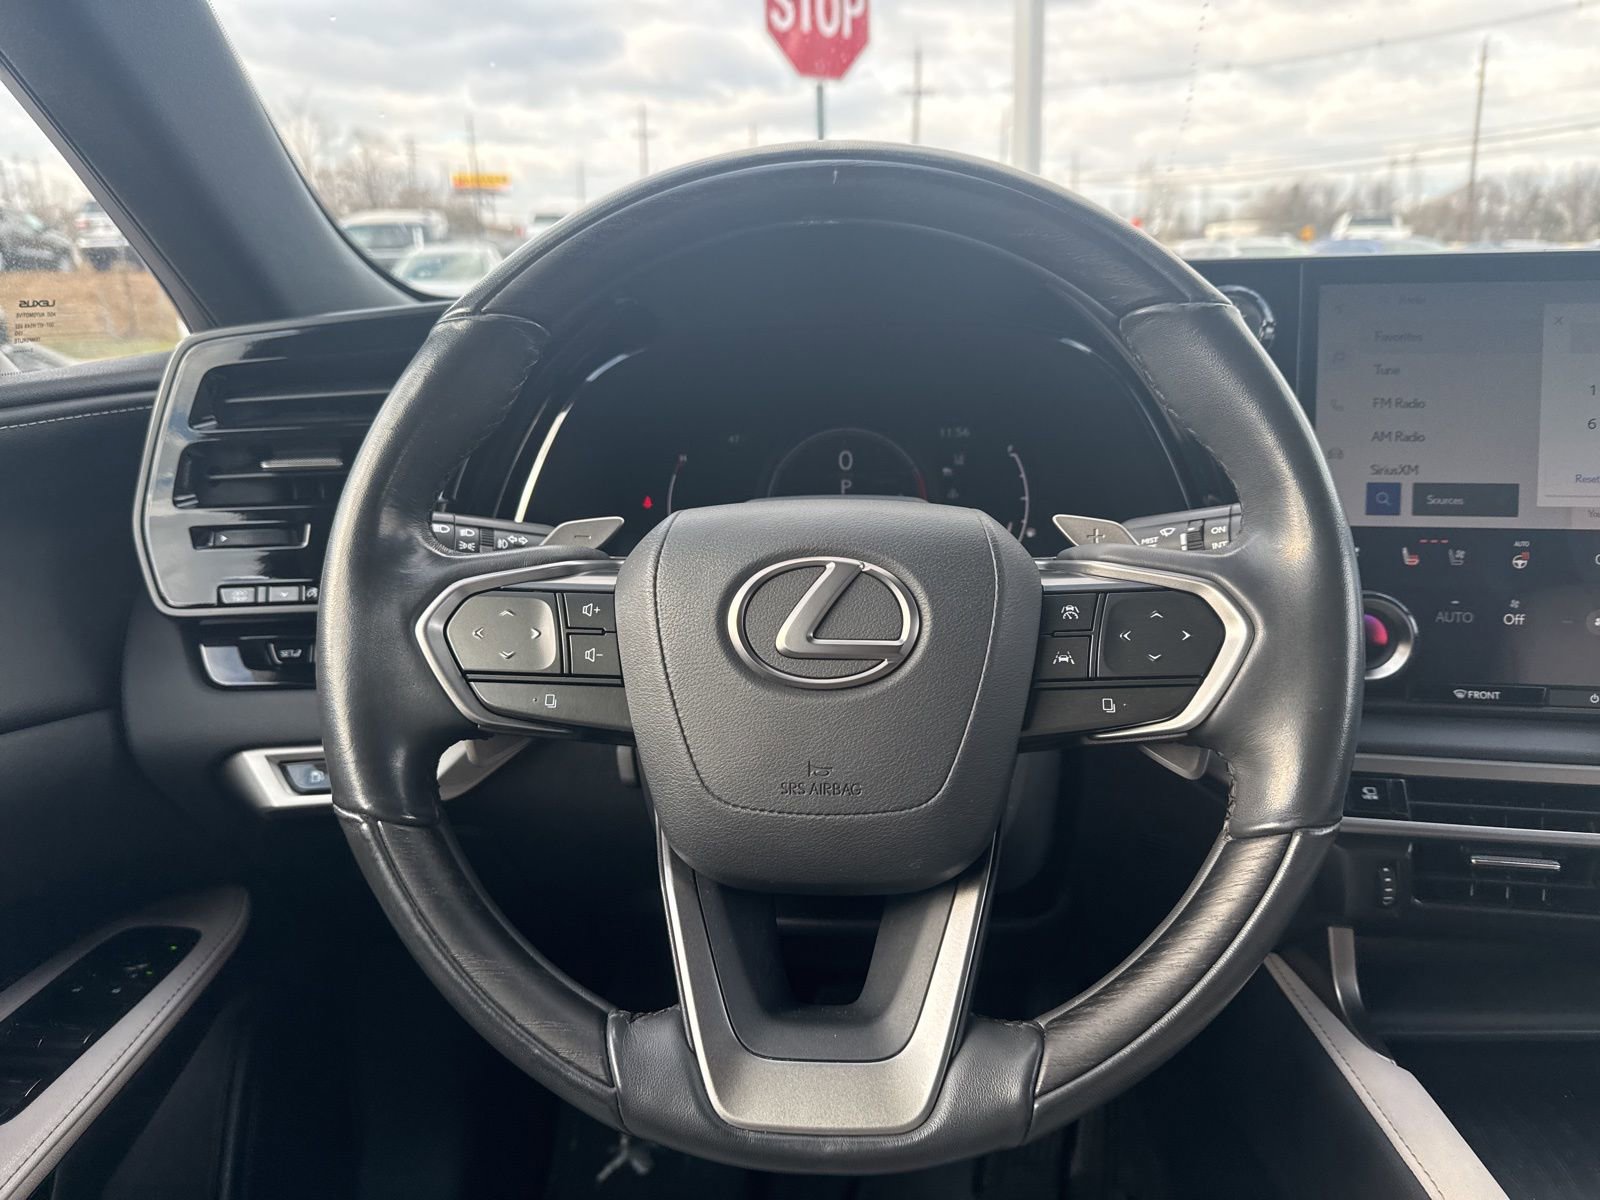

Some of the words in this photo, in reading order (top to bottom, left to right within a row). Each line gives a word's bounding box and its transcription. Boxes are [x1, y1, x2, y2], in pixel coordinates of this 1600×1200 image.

[769, 0, 865, 40] STOP
[1374, 331, 1423, 343] Favorites
[1373, 364, 1400, 376] Tune
[1590, 385, 1597, 396] 1
[1372, 399, 1393, 410] FM
[1394, 398, 1426, 410] Radio
[1587, 418, 1598, 430] 6
[1370, 431, 1393, 443] AM
[1394, 431, 1426, 443] Radio
[1369, 464, 1420, 476] SiriusXM
[840, 479, 852, 494] P
[1426, 494, 1464, 506] Sources
[1210, 525, 1227, 535] ON
[1141, 536, 1159, 545] MIST
[1513, 540, 1531, 548] AUTO
[1435, 611, 1475, 624] AUTO
[1503, 613, 1526, 626] Off
[1467, 690, 1501, 701] FRONT
[780, 782, 806, 796] SRS
[809, 782, 863, 796] AIRBAG
